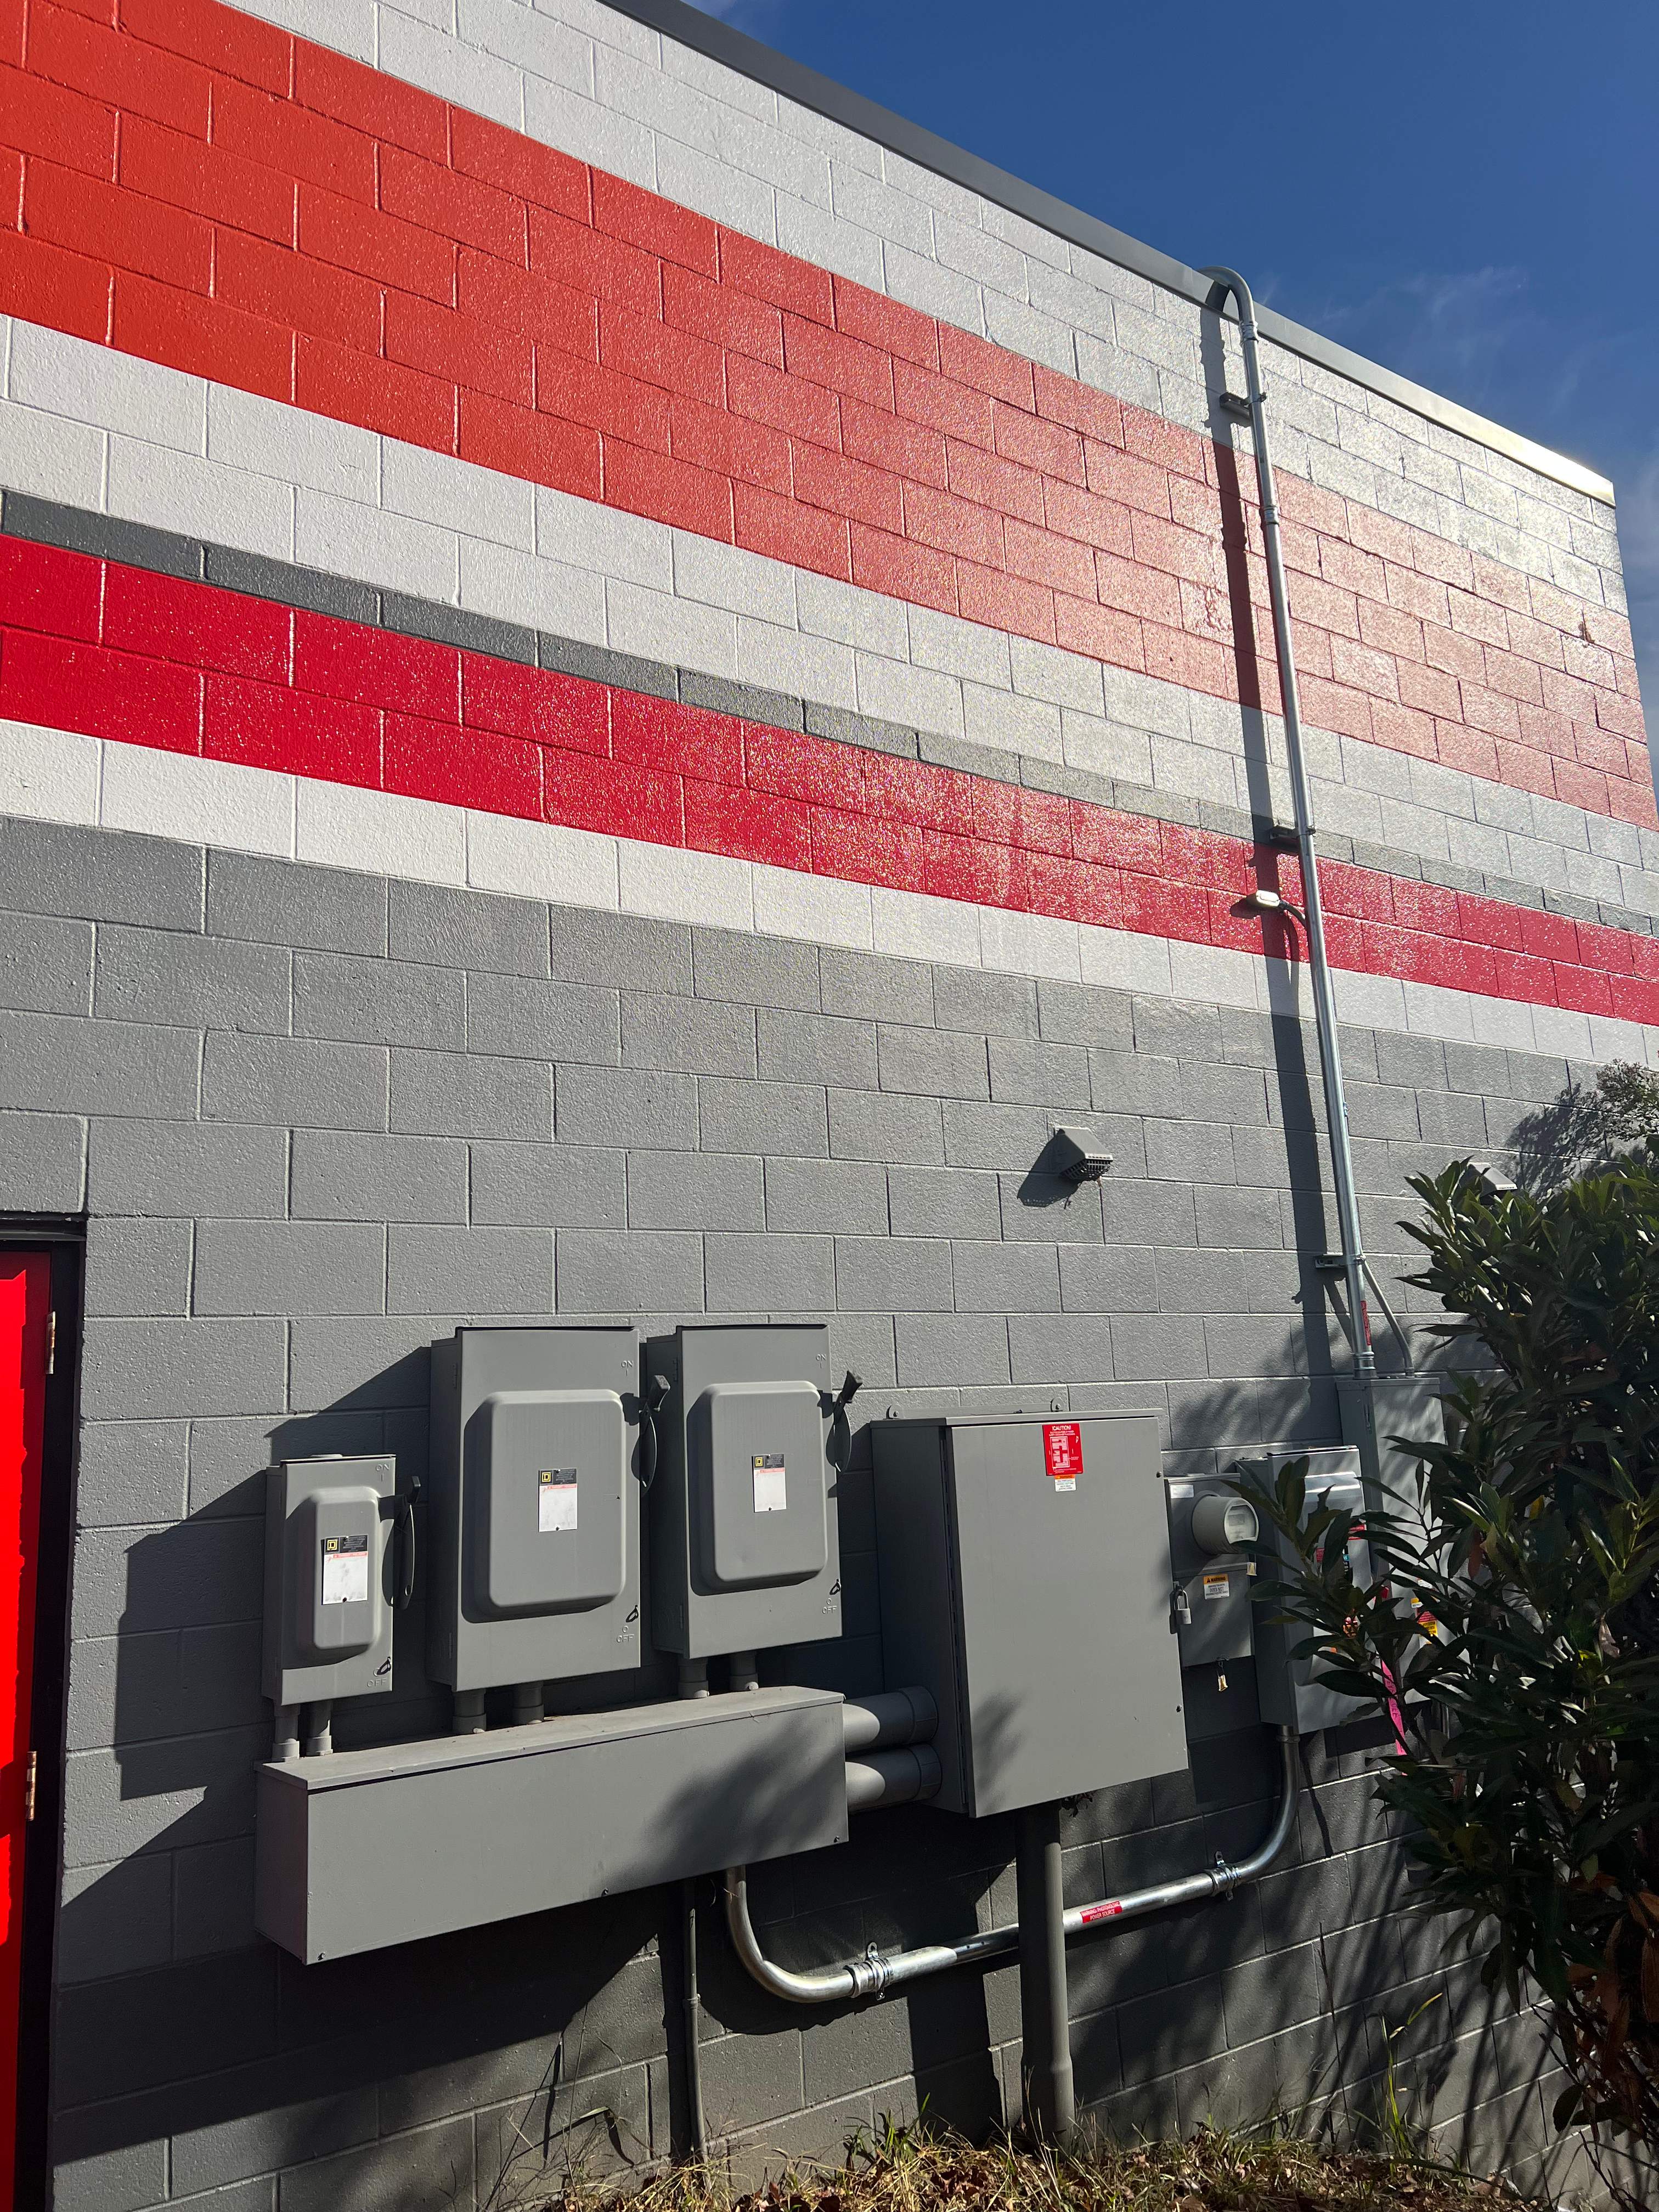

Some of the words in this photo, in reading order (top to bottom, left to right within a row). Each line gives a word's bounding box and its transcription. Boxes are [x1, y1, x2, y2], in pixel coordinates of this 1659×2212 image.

[375, 1463, 390, 1471] ON
[822, 1605, 837, 1614] OFF
[616, 1634, 634, 1643] OFF
[366, 1678, 387, 1688] OFF
